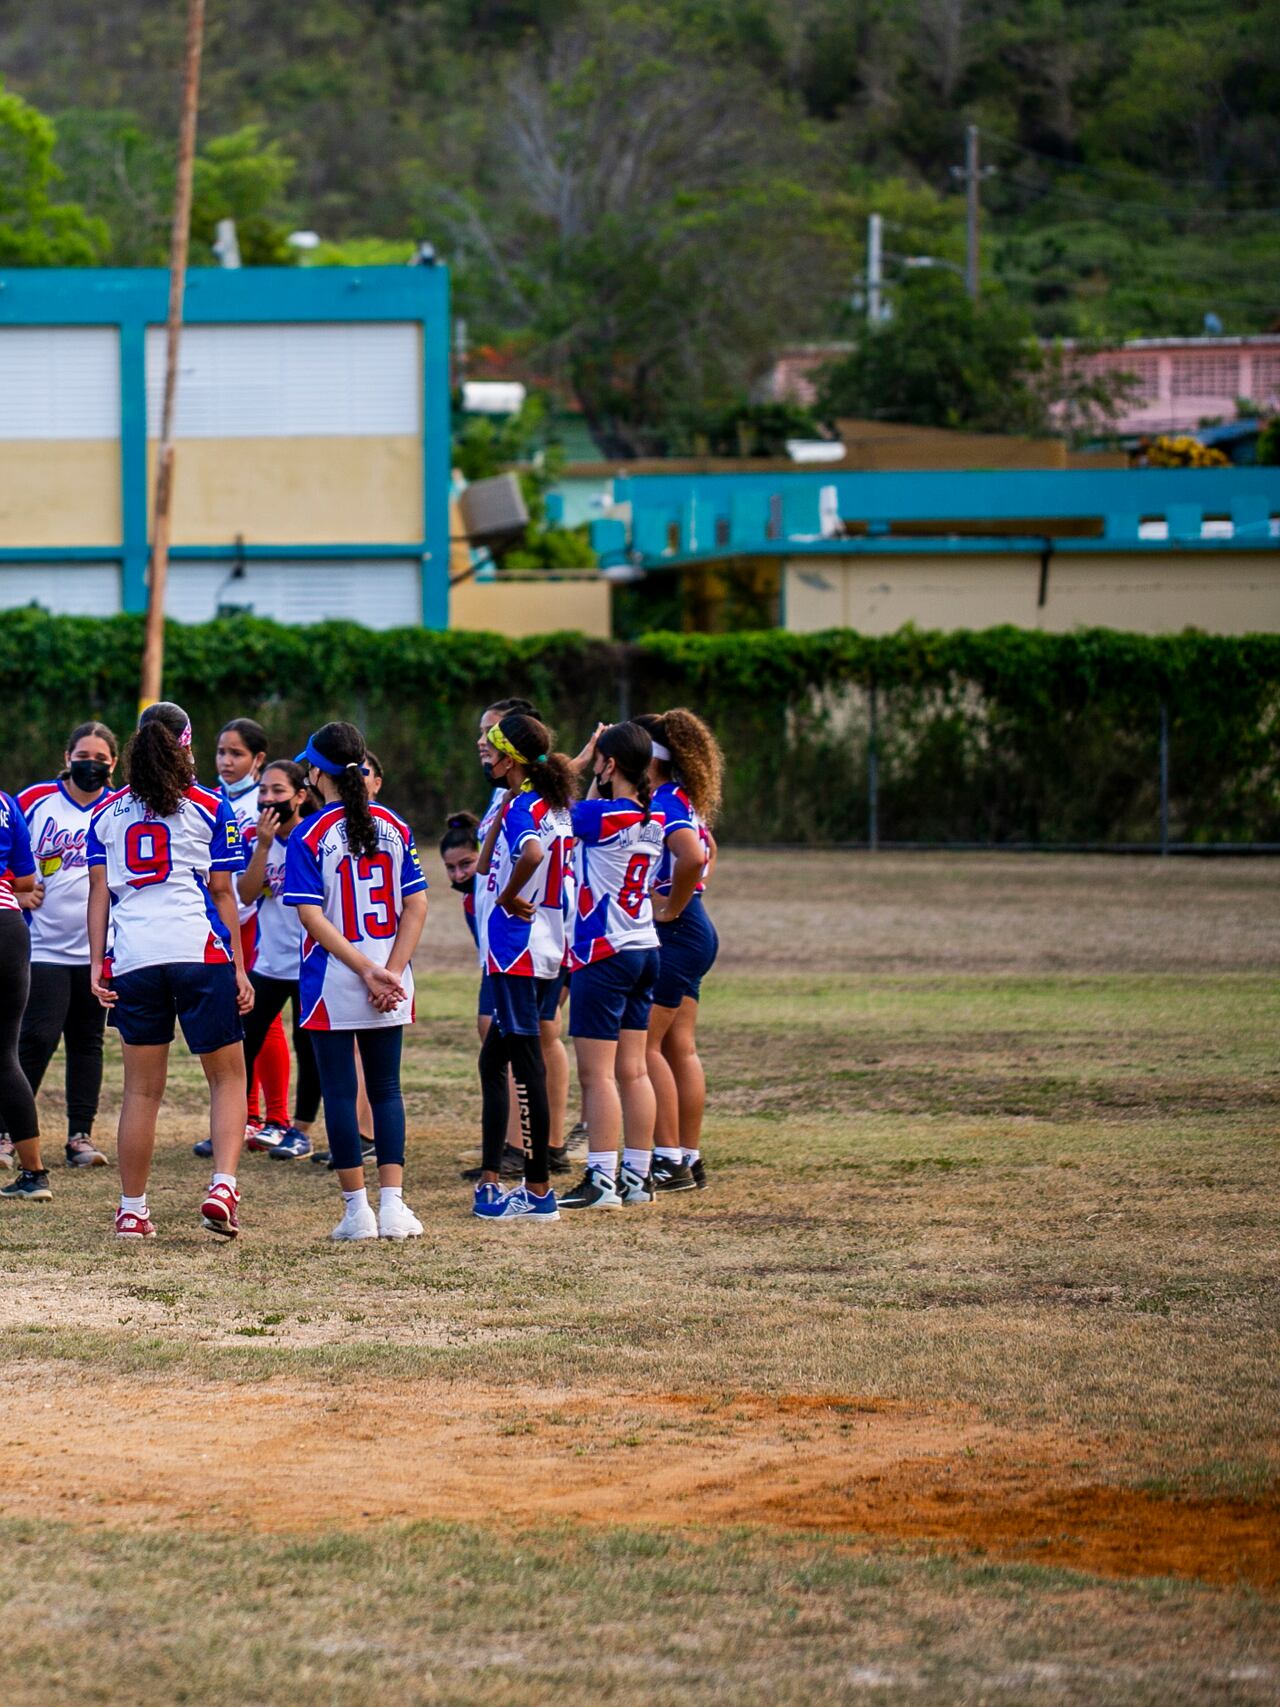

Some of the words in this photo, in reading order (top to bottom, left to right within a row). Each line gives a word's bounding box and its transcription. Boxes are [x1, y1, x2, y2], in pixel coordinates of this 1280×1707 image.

[125, 821, 173, 890] 9
[617, 853, 650, 919] 8
[335, 851, 398, 943] 13
